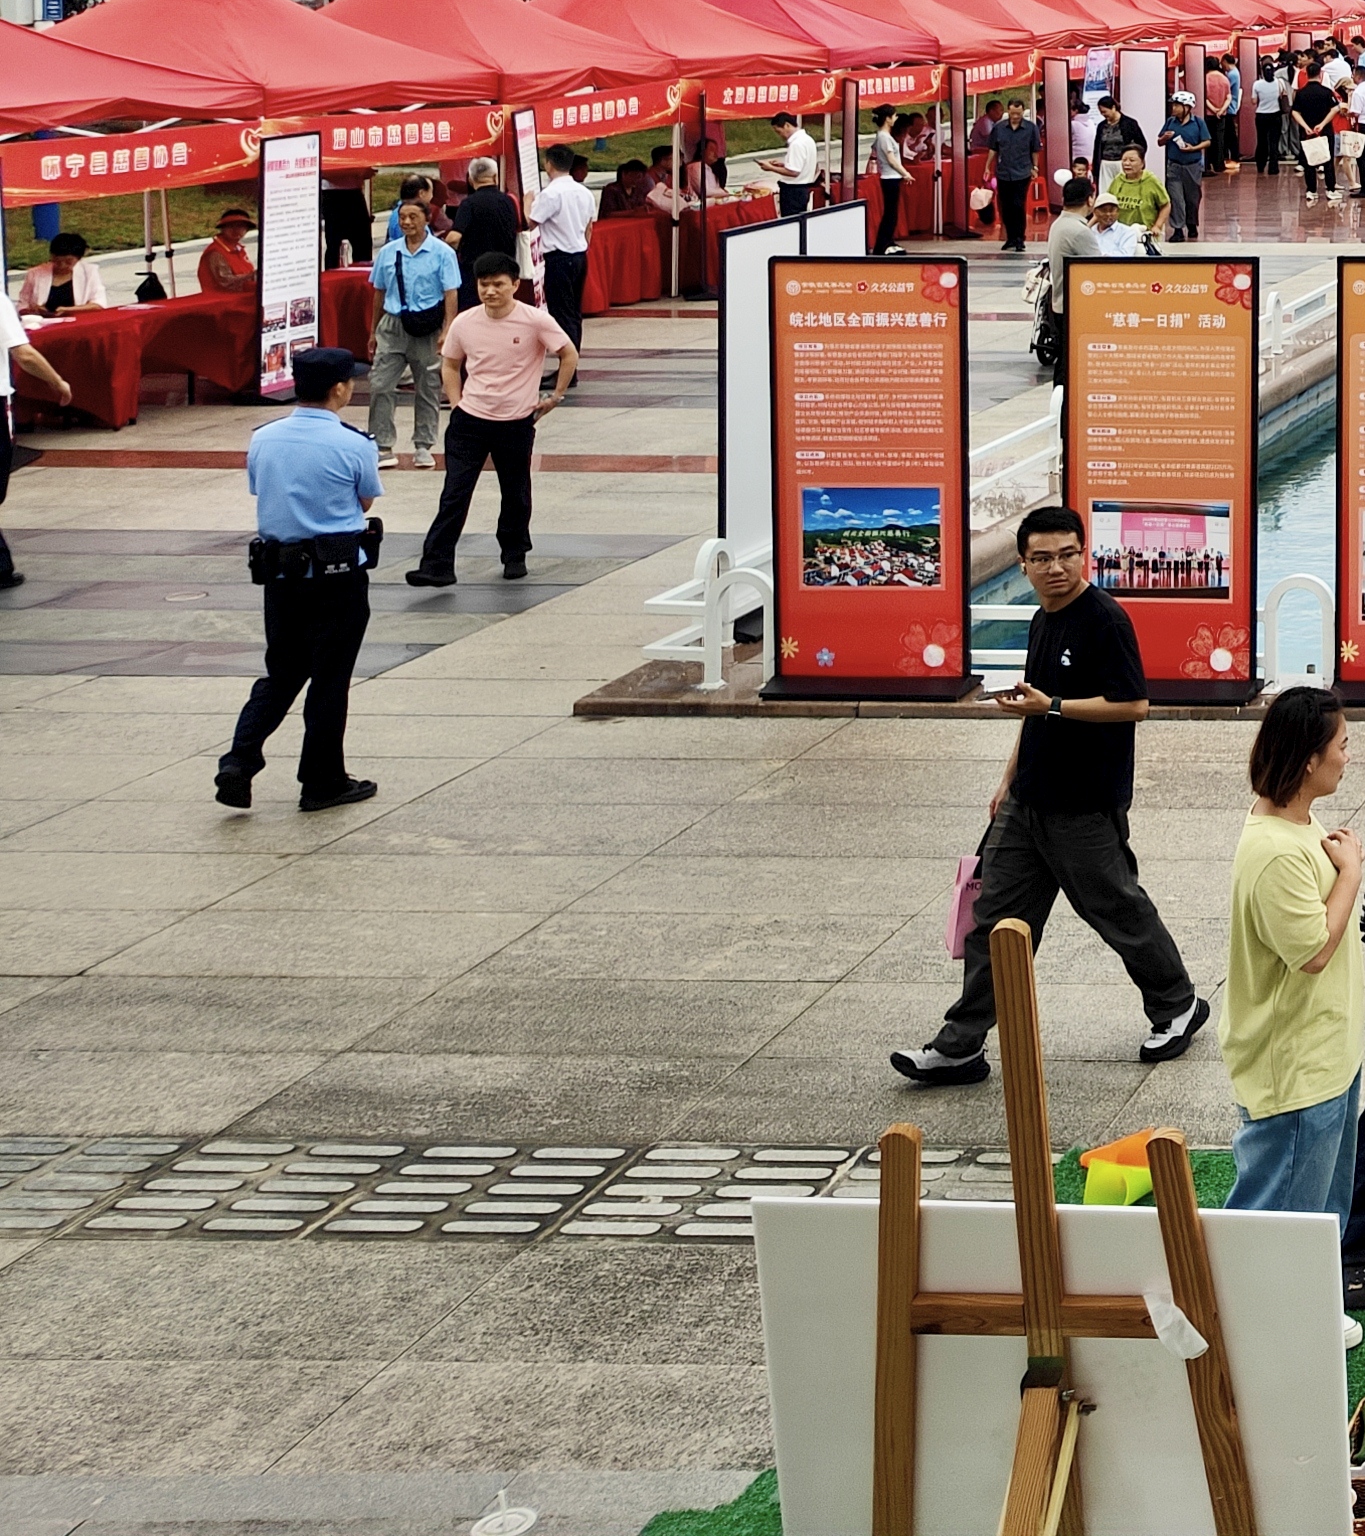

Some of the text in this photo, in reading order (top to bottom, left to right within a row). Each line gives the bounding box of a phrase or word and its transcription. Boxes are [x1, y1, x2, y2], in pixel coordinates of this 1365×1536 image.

[333, 121, 451, 151] 潜山市慈善总会
[41, 142, 188, 180] 怀宁县慈善协会
[790, 312, 948, 328] 皖北地区全面振兴慈善行
